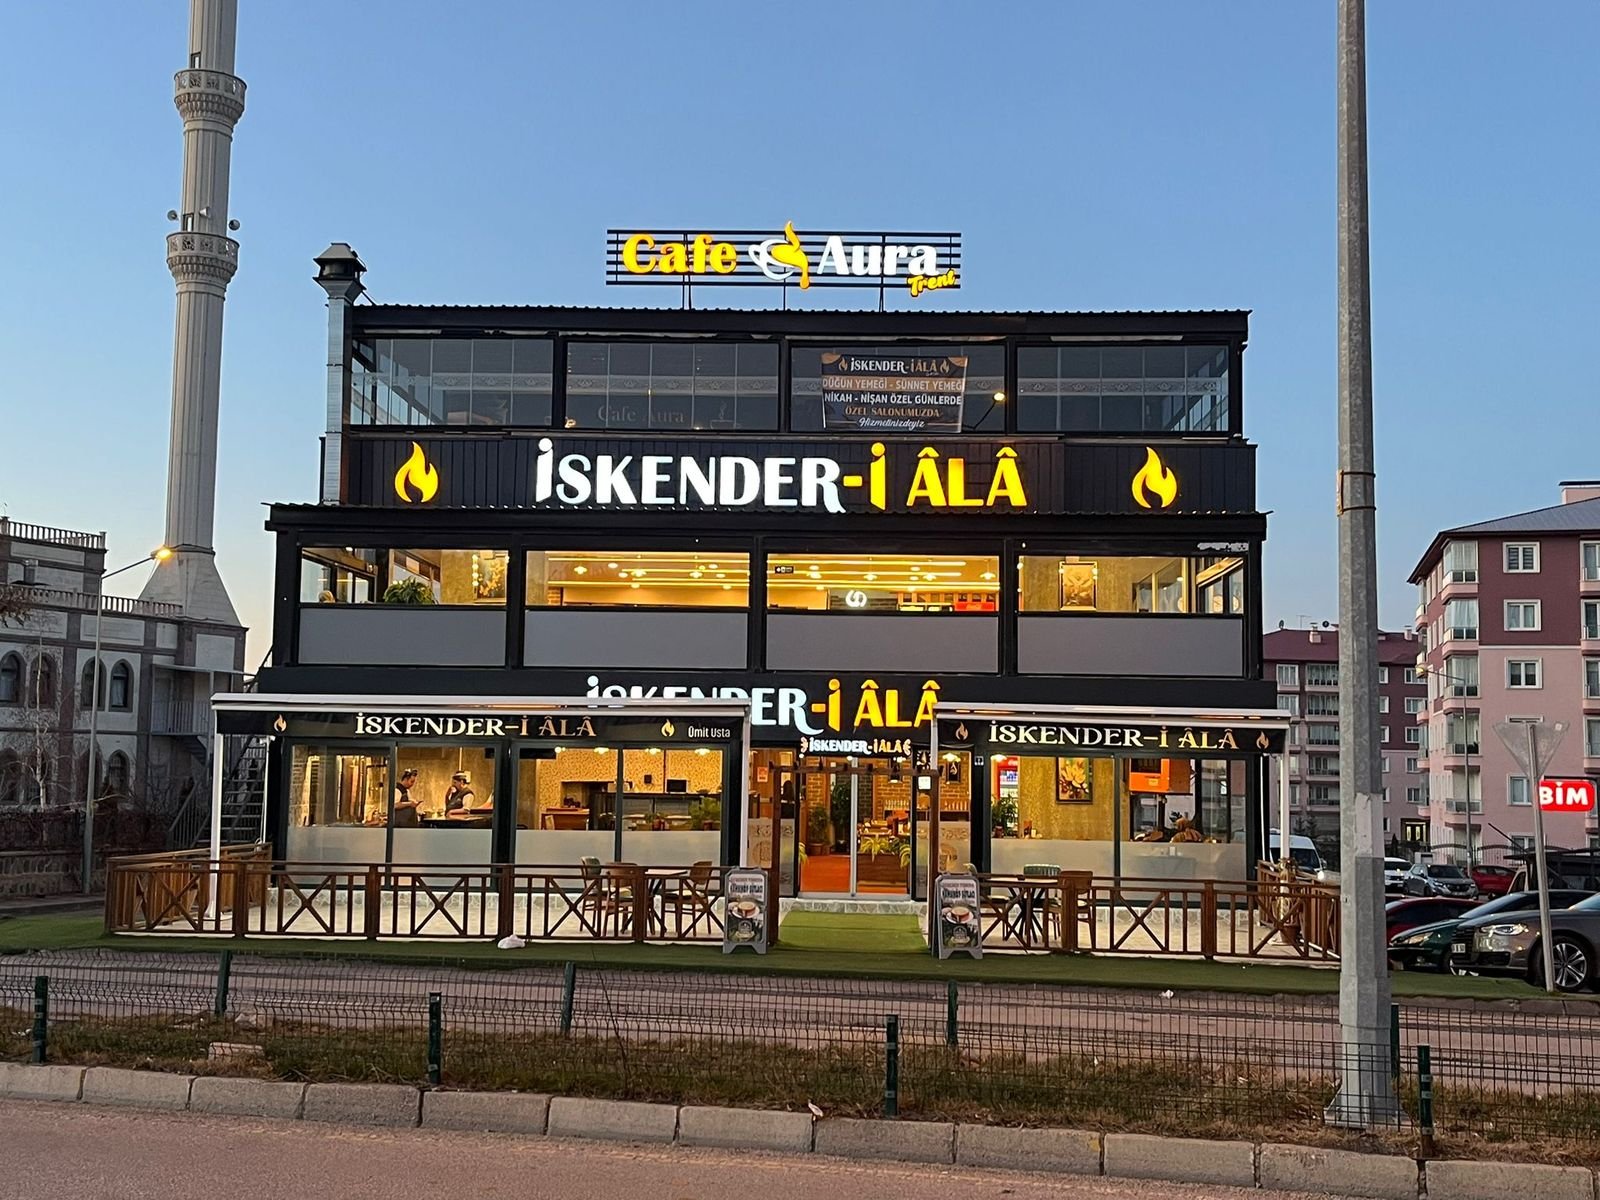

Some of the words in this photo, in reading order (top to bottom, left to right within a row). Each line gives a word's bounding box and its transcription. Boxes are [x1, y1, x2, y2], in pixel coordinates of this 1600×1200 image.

[622, 233, 737, 274] Cafe
[816, 235, 941, 276] Aura
[907, 269, 956, 297] Trent
[822, 375, 852, 389] DÜĞÜN
[855, 377, 888, 390] YEMEĞİ
[895, 378, 930, 391] SÜNNET
[824, 391, 852, 403] NİKAH
[860, 392, 888, 405] NİŞAN
[890, 393, 913, 404] ÖZEL
[915, 393, 962, 406] GÜNLERDE
[845, 405, 868, 416] ÖZEL
[871, 406, 940, 418] SALONUMUZDA
[906, 446, 1028, 507] ÂLÂ
[354, 712, 529, 736] İSKENDER-İ
[538, 715, 597, 737] ÂLÂ
[710, 727, 731, 738] Usta
[988, 720, 1169, 748] İSKENDER-İ
[1178, 727, 1239, 749] ÂLÂ
[1539, 781, 1589, 806] BİM
